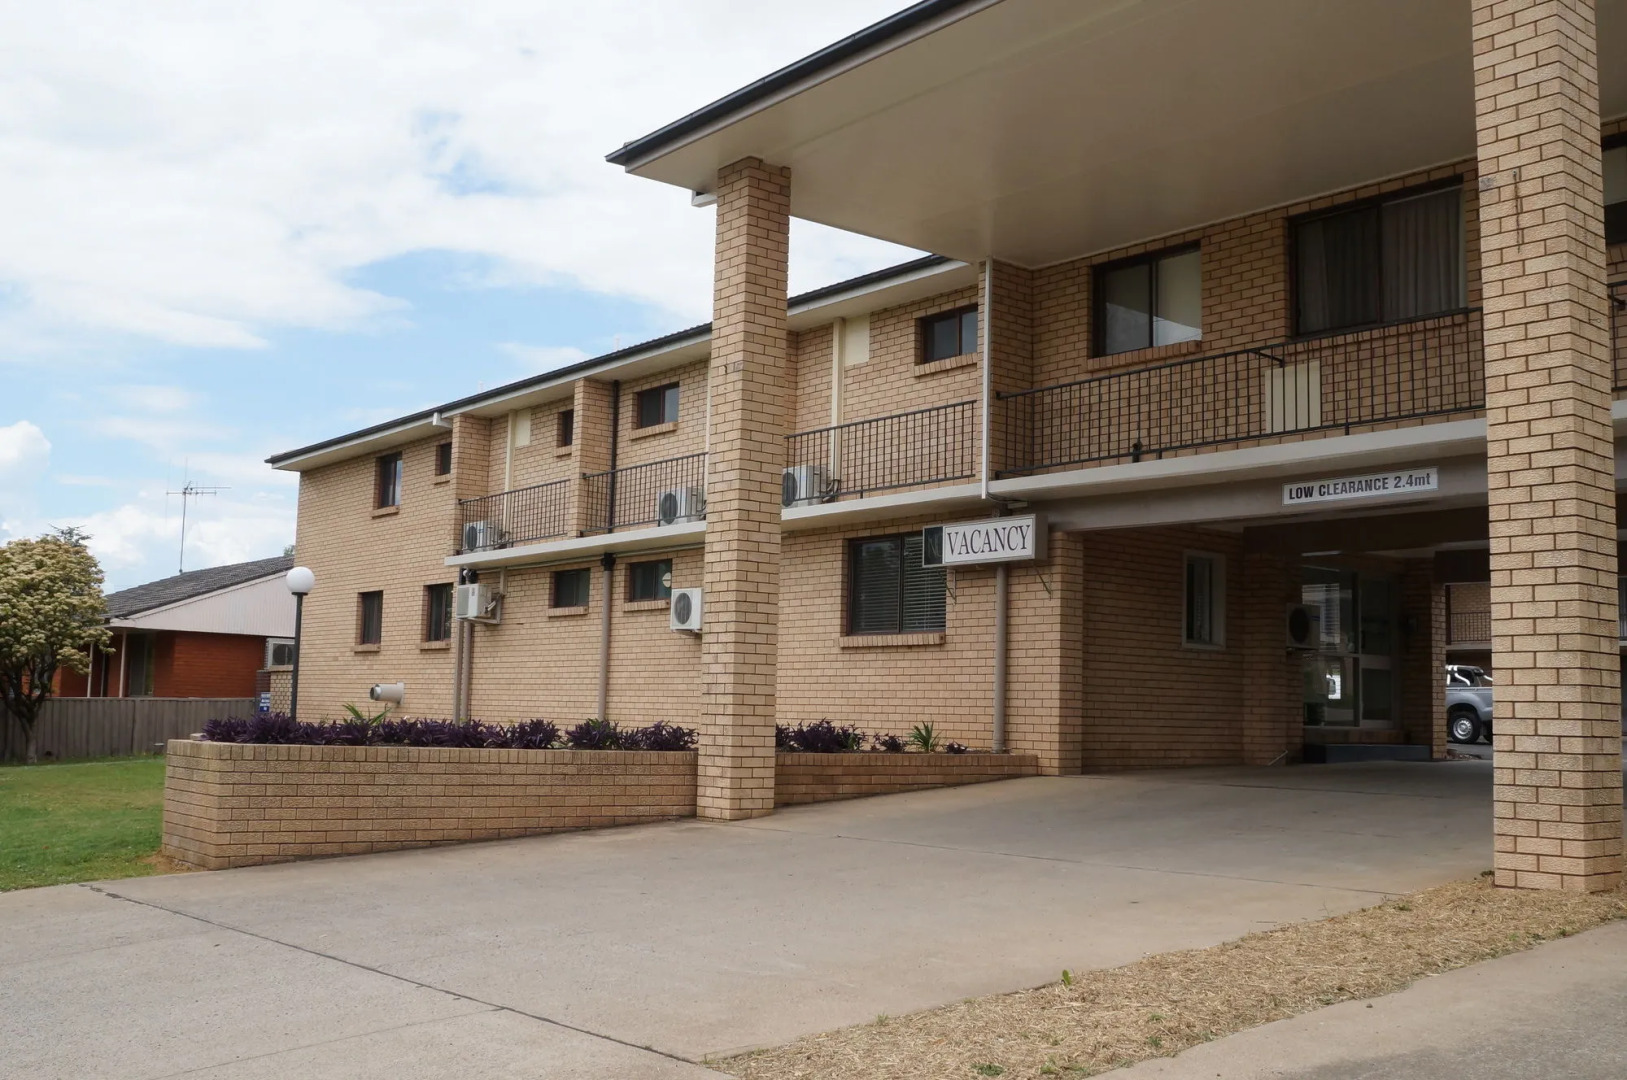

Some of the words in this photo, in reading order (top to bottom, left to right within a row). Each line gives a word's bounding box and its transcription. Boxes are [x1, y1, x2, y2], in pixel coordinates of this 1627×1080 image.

[1289, 487, 1314, 500] LOW
[1318, 477, 1389, 497] CLEARANCE
[1393, 472, 1431, 489] 2.4mt
[946, 524, 1031, 555] VACANCY
